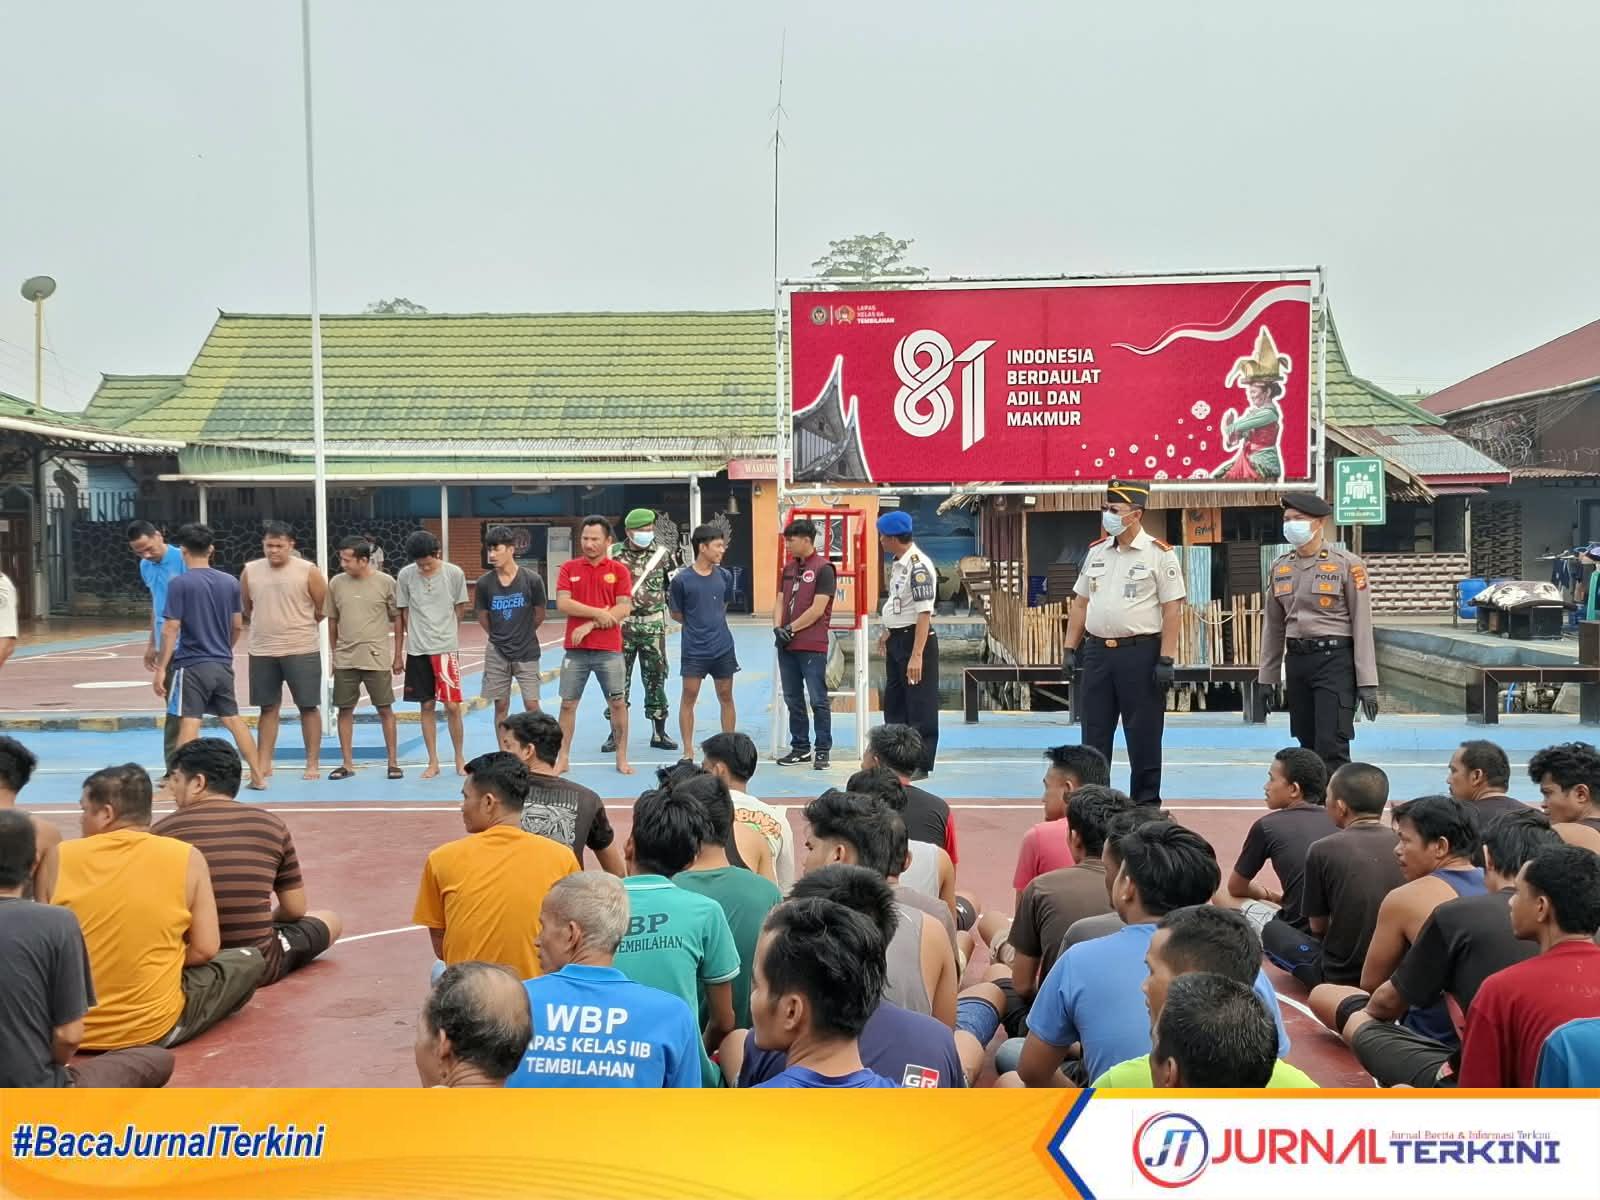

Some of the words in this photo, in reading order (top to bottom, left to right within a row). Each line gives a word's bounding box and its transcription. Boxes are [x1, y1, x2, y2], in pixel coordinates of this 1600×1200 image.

[1006, 348, 1095, 365] INDONESIA
[1006, 369, 1101, 386] BERDAULAT
[893, 329, 998, 452] 81
[1006, 391, 1043, 406] ADIL
[1047, 390, 1081, 405] DAN
[1006, 411, 1081, 427] MAKMUR
[491, 597, 525, 610] SOCCER
[546, 1003, 629, 1034] WBP
[572, 1037, 627, 1055] KELAS
[630, 1041, 651, 1058] IIB
[526, 1057, 635, 1078] TEMBILAHAN
